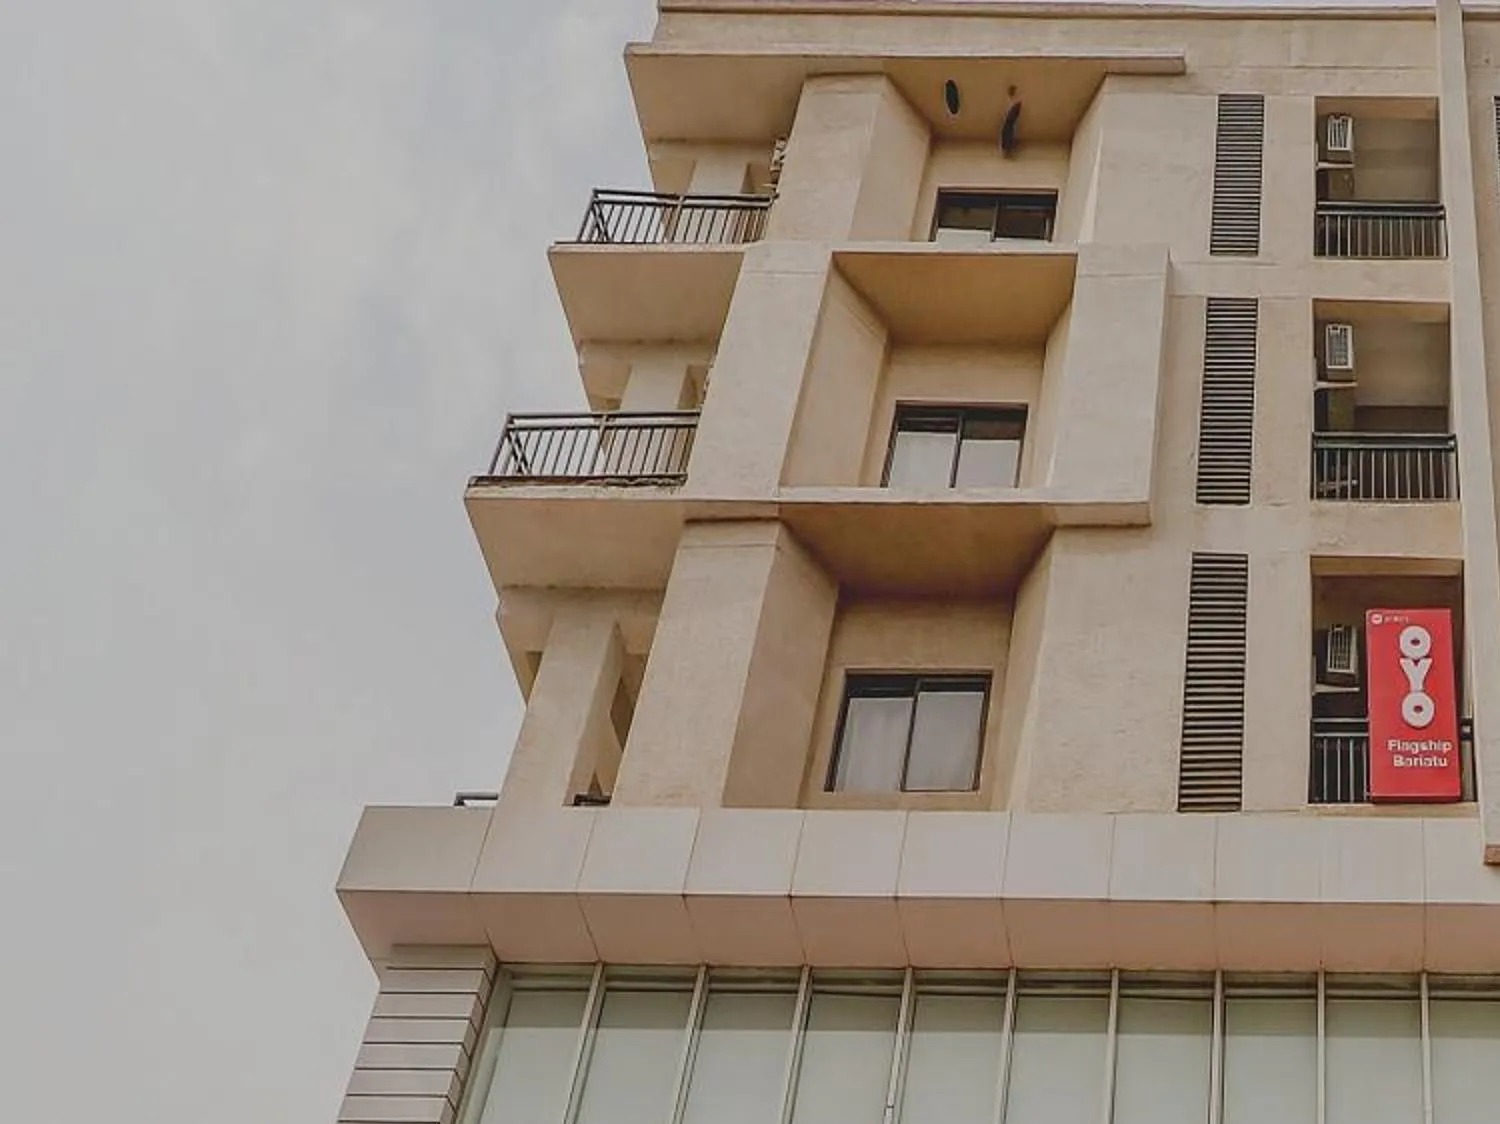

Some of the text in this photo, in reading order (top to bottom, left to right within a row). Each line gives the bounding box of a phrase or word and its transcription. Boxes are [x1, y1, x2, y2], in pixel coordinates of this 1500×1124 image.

[1400, 625, 1435, 728] OYO
[1387, 739, 1453, 754] Flagship
[1393, 754, 1449, 767] Bariatu
